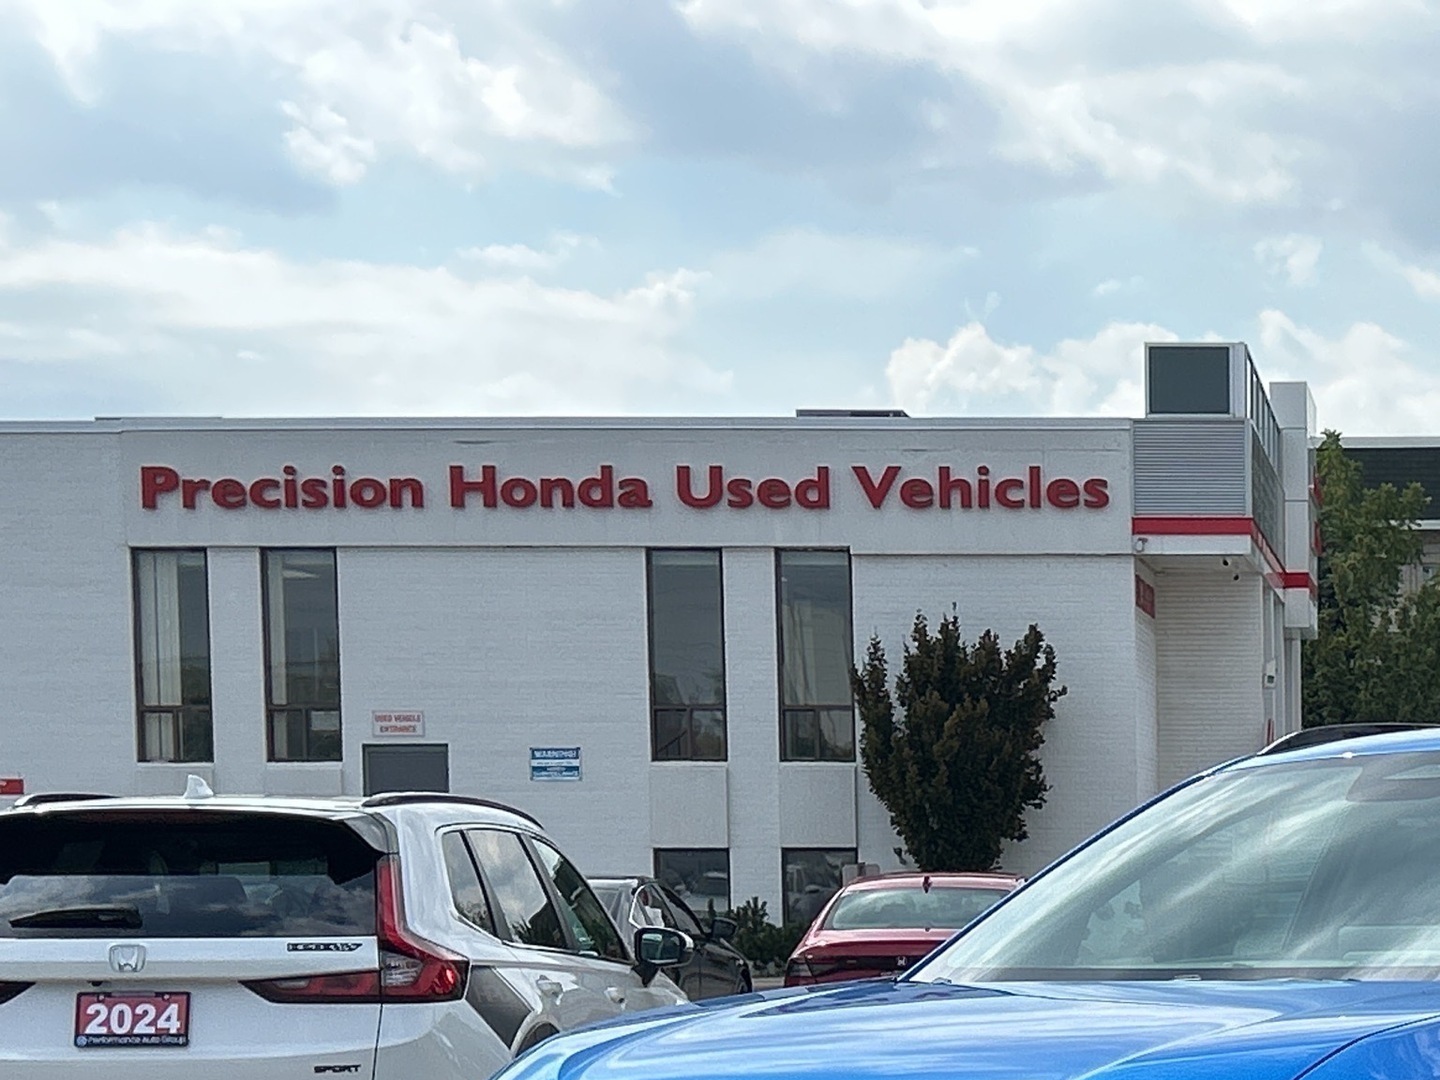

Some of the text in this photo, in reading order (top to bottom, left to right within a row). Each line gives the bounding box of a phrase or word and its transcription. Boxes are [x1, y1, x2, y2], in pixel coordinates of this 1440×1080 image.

[141, 465, 1110, 509] Precision Honda Used Vehicles
[84, 1002, 181, 1035] 2024
